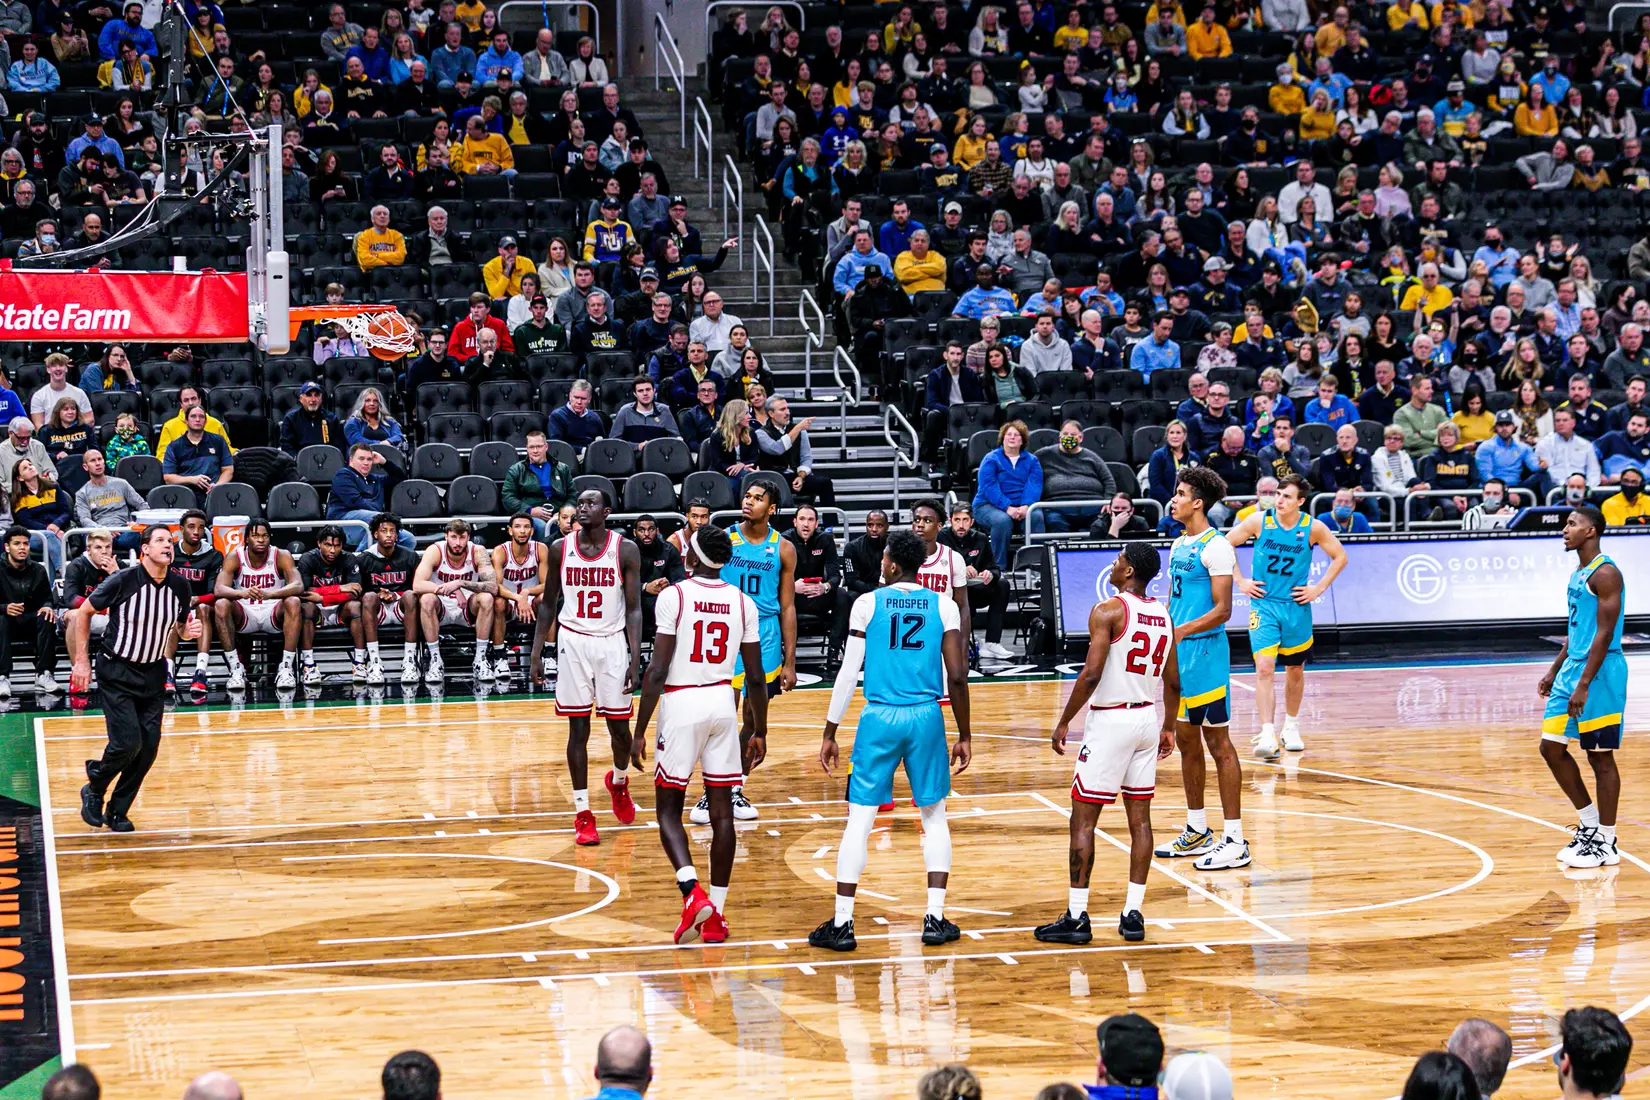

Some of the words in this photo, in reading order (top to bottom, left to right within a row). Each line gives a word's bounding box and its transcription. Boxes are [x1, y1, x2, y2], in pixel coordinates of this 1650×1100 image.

[227, 530, 240, 545] G
[1262, 539, 1305, 554] Marquette
[1266, 555, 1295, 576] 22
[1448, 556, 1535, 571] GORDON
[241, 574, 275, 588] HUSKIES
[371, 571, 407, 585] NIU
[503, 566, 537, 581] HUSKIES
[566, 567, 615, 587] HUSKIES
[740, 573, 763, 596] 10
[577, 591, 602, 618] 12
[886, 598, 929, 610] PROSPER
[1137, 613, 1167, 627] HUNTER
[889, 613, 926, 650] 12
[689, 620, 729, 664] 13
[1126, 631, 1168, 677] 24
